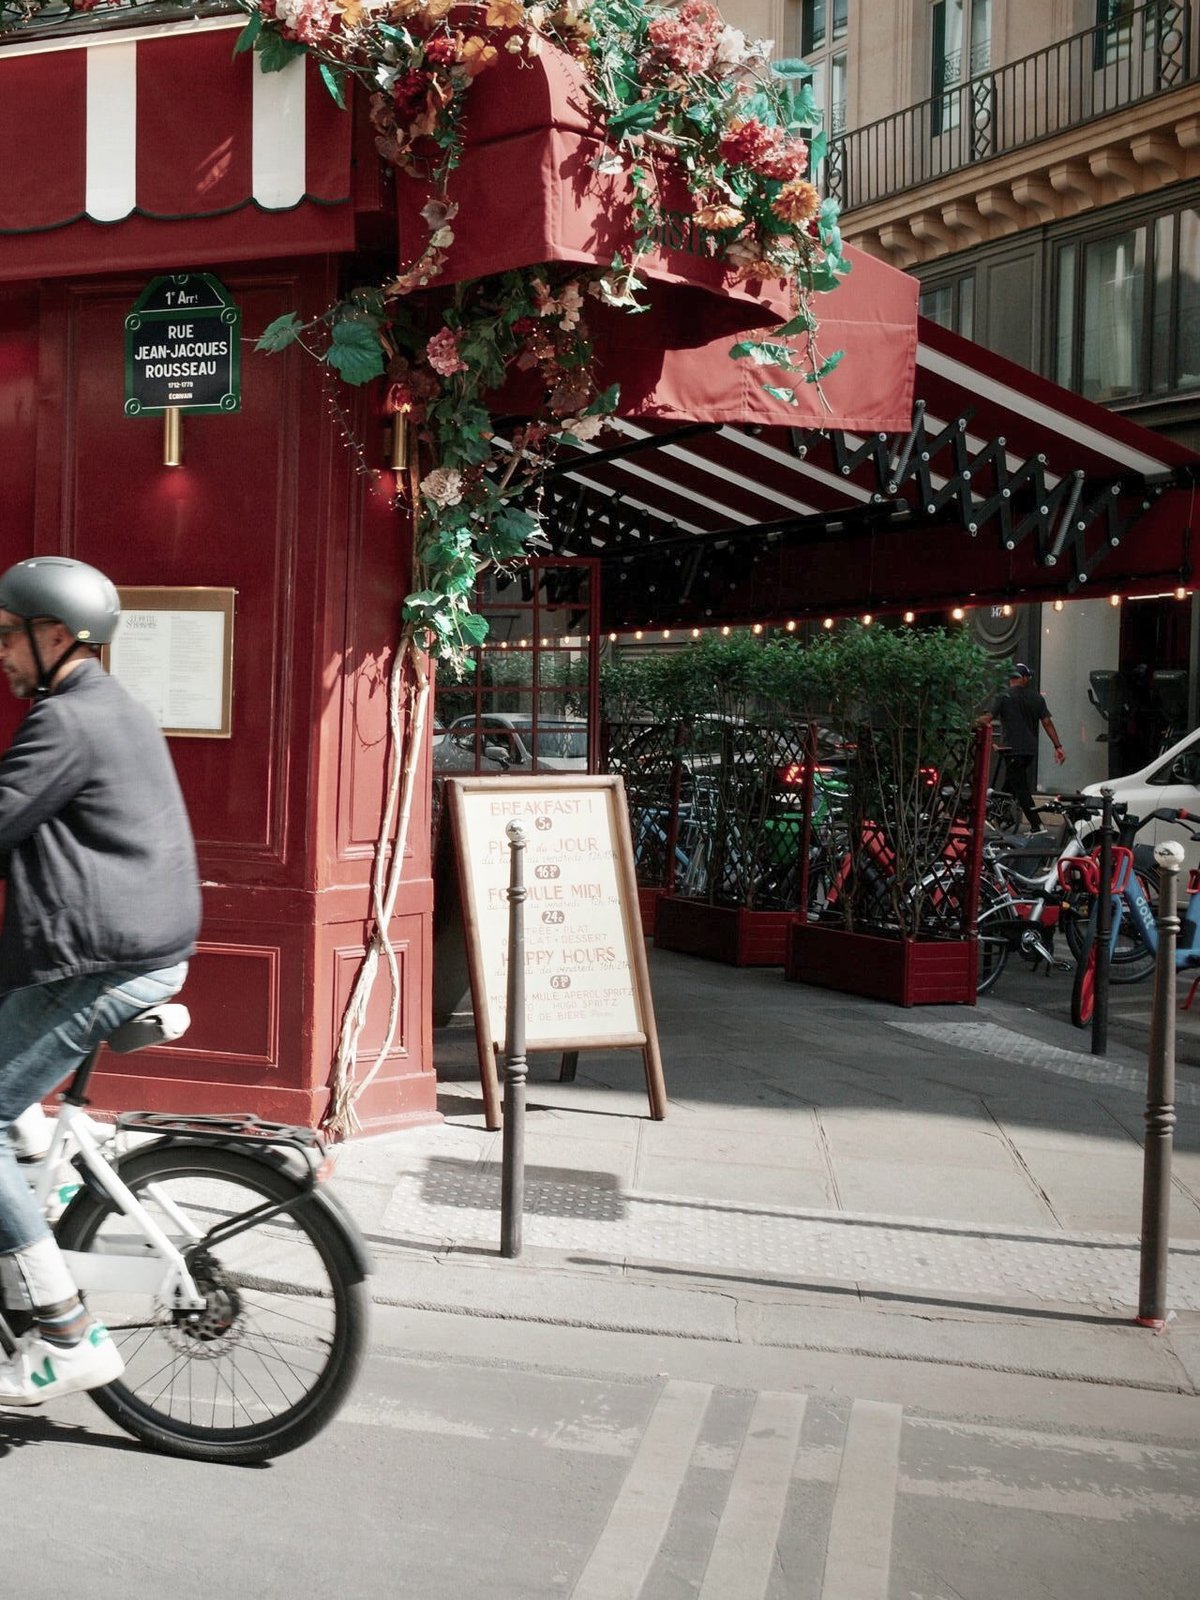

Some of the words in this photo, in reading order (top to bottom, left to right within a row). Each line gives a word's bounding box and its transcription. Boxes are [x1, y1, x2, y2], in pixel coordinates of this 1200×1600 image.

[168, 324, 194, 339] RUE
[134, 341, 228, 360] JEAN-JACQUES
[145, 360, 217, 378] ROUSSEAU
[489, 799, 581, 816] BREAKFAST
[488, 840, 531, 856] PLT
[553, 837, 599, 852] JOUR
[487, 885, 564, 903] FOMULE
[570, 883, 602, 899] MIDI
[560, 933, 608, 945] DESSERT
[501, 949, 554, 966] HPPY
[562, 946, 616, 963] HOURS
